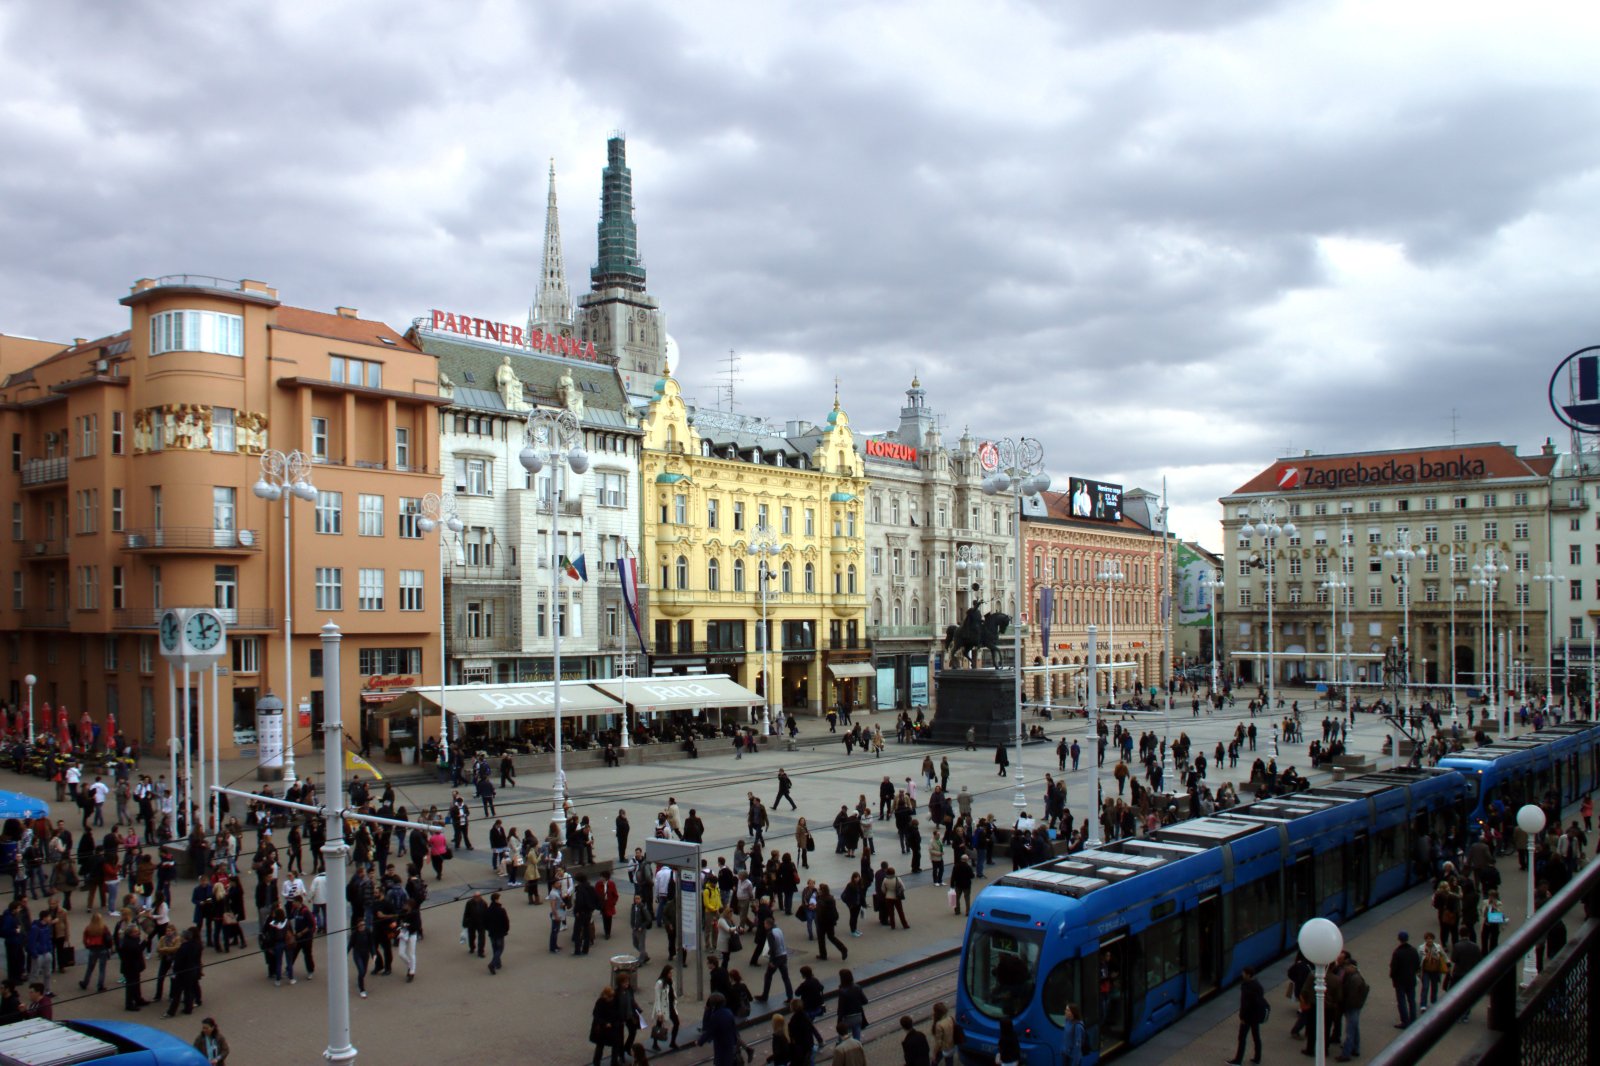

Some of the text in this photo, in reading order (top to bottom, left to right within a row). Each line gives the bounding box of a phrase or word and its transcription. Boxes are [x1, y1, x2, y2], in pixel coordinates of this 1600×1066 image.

[433, 309, 597, 361] PARTNER BANKA
[866, 439, 917, 462] KONZUM
[1304, 454, 1485, 490] Zagrebačka banka
[641, 683, 720, 701] Jana
